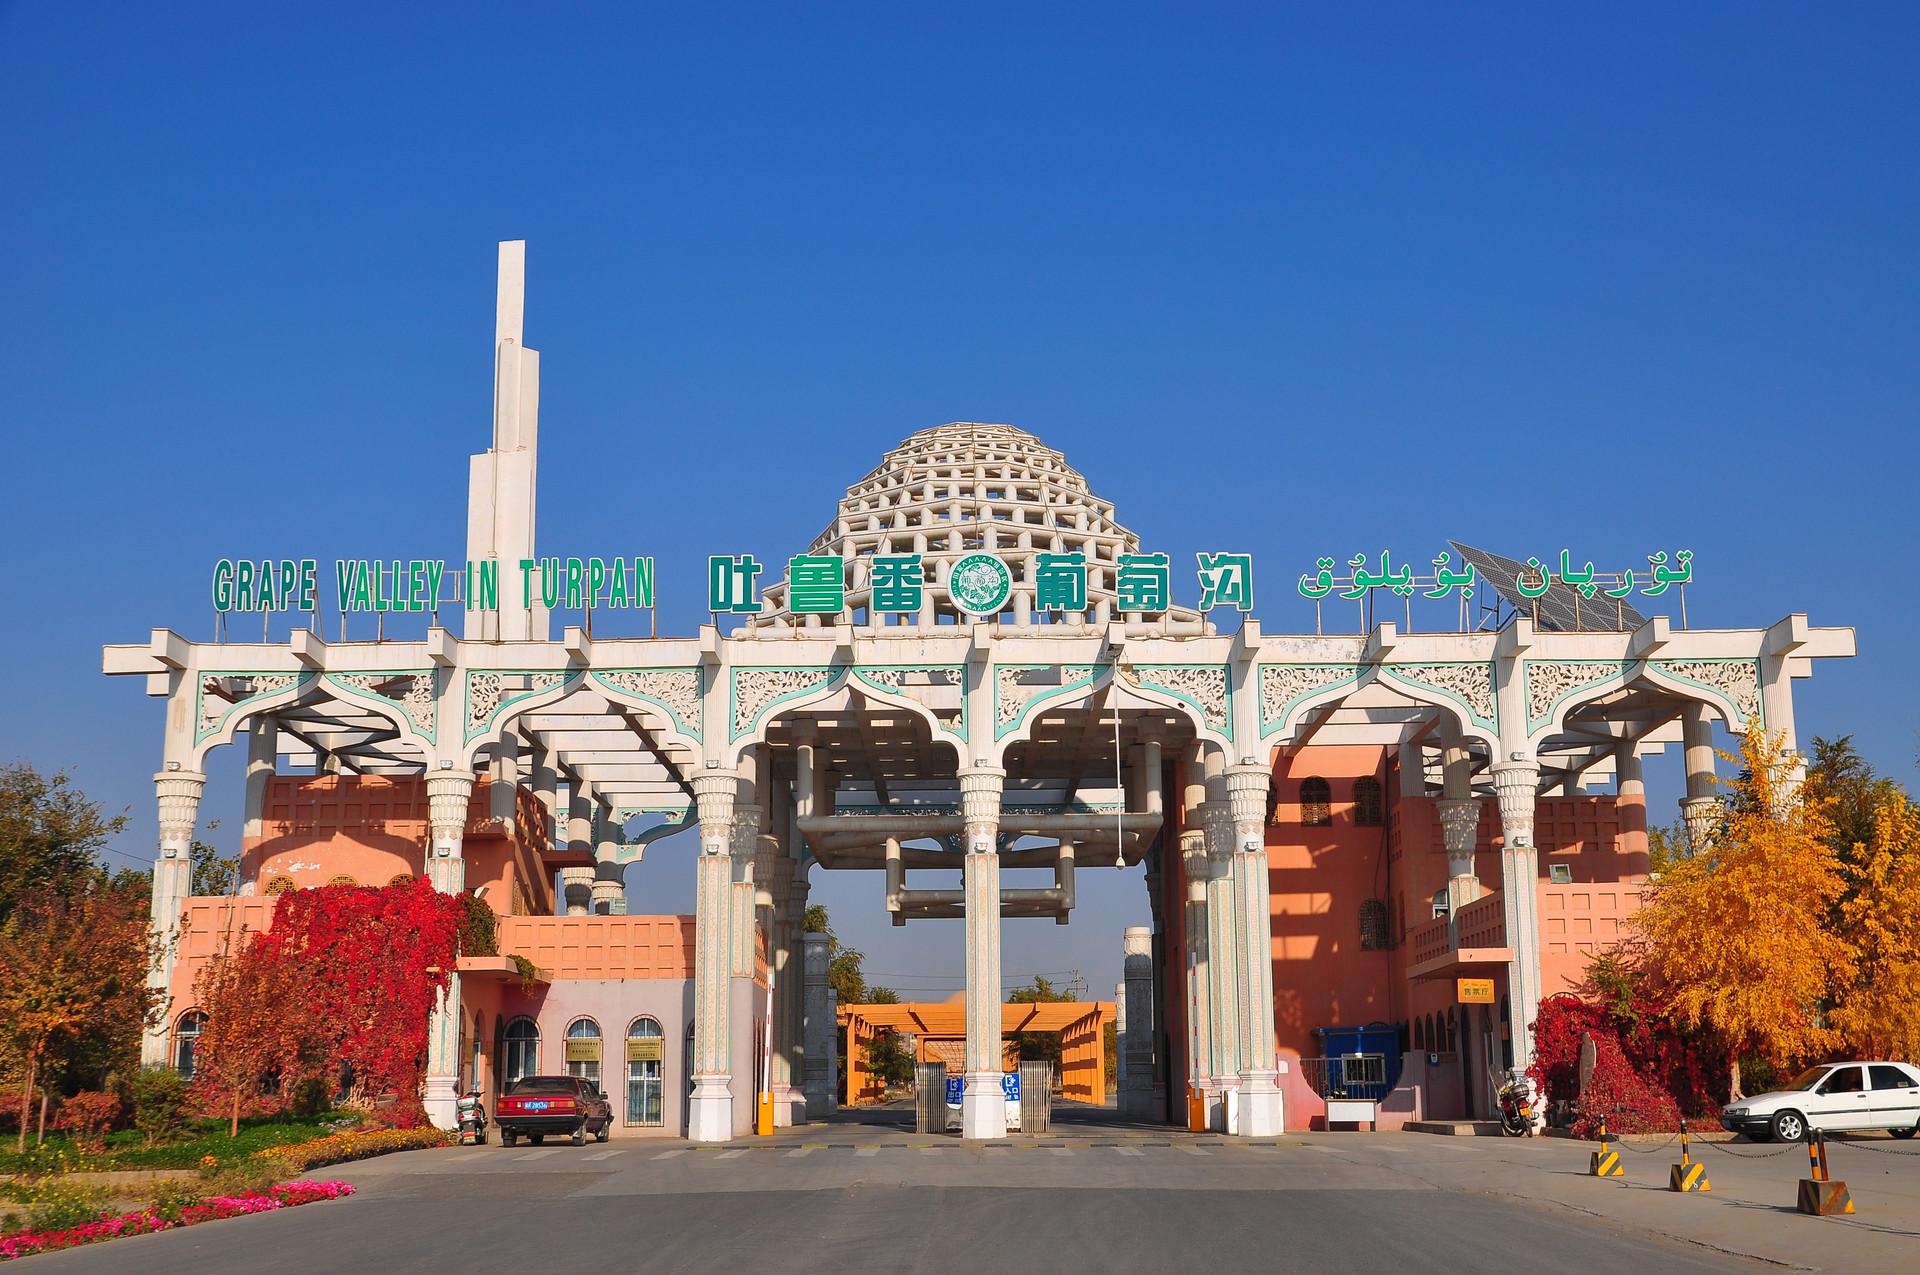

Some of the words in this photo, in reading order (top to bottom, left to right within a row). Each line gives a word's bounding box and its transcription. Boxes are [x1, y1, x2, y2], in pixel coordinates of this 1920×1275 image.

[212, 558, 317, 612] GRAPE
[335, 559, 445, 612] VALLEY
[465, 559, 498, 611] IN
[518, 556, 655, 609] TURPAN
